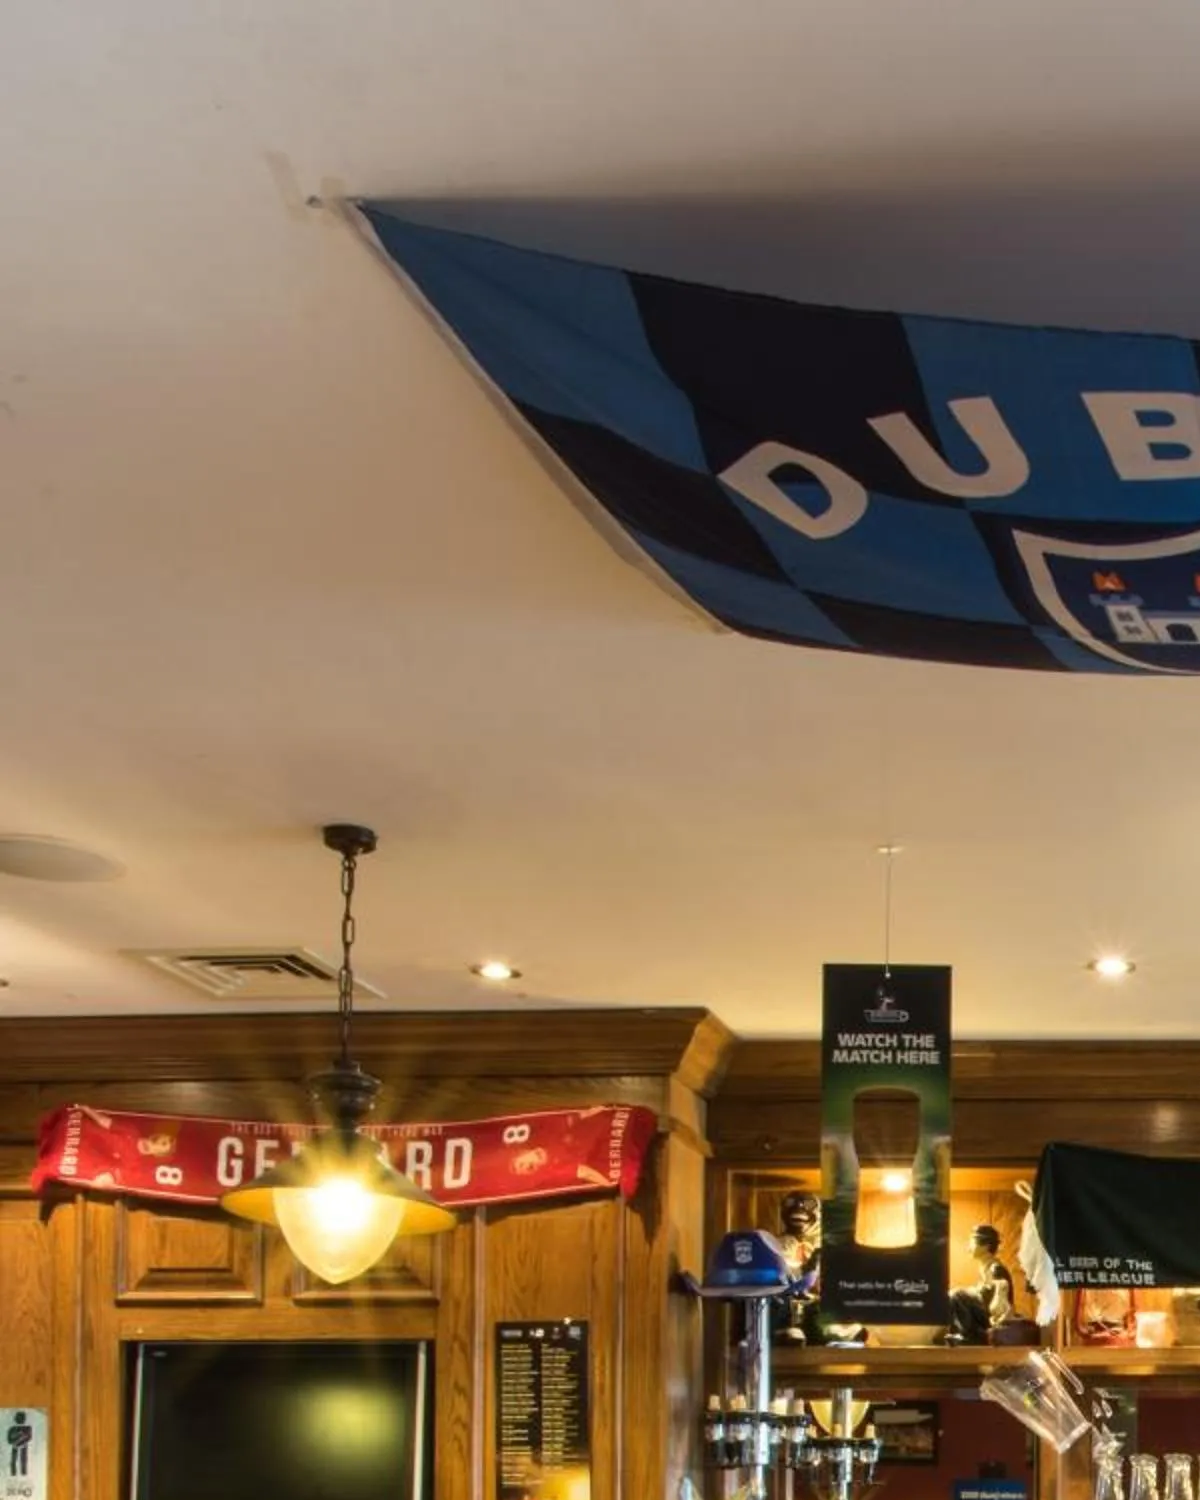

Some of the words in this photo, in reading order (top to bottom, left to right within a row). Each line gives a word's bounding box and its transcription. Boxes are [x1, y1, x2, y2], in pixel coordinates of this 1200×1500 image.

[837, 1032, 898, 1048] WATCH
[901, 1033, 936, 1048] THE
[832, 1049, 893, 1064] MATCH
[896, 1051, 940, 1065] HERE
[503, 1123, 531, 1144] 8
[216, 1136, 473, 1190] GERD
[155, 1165, 183, 1186] 8
[1125, 1258, 1153, 1270] THE
